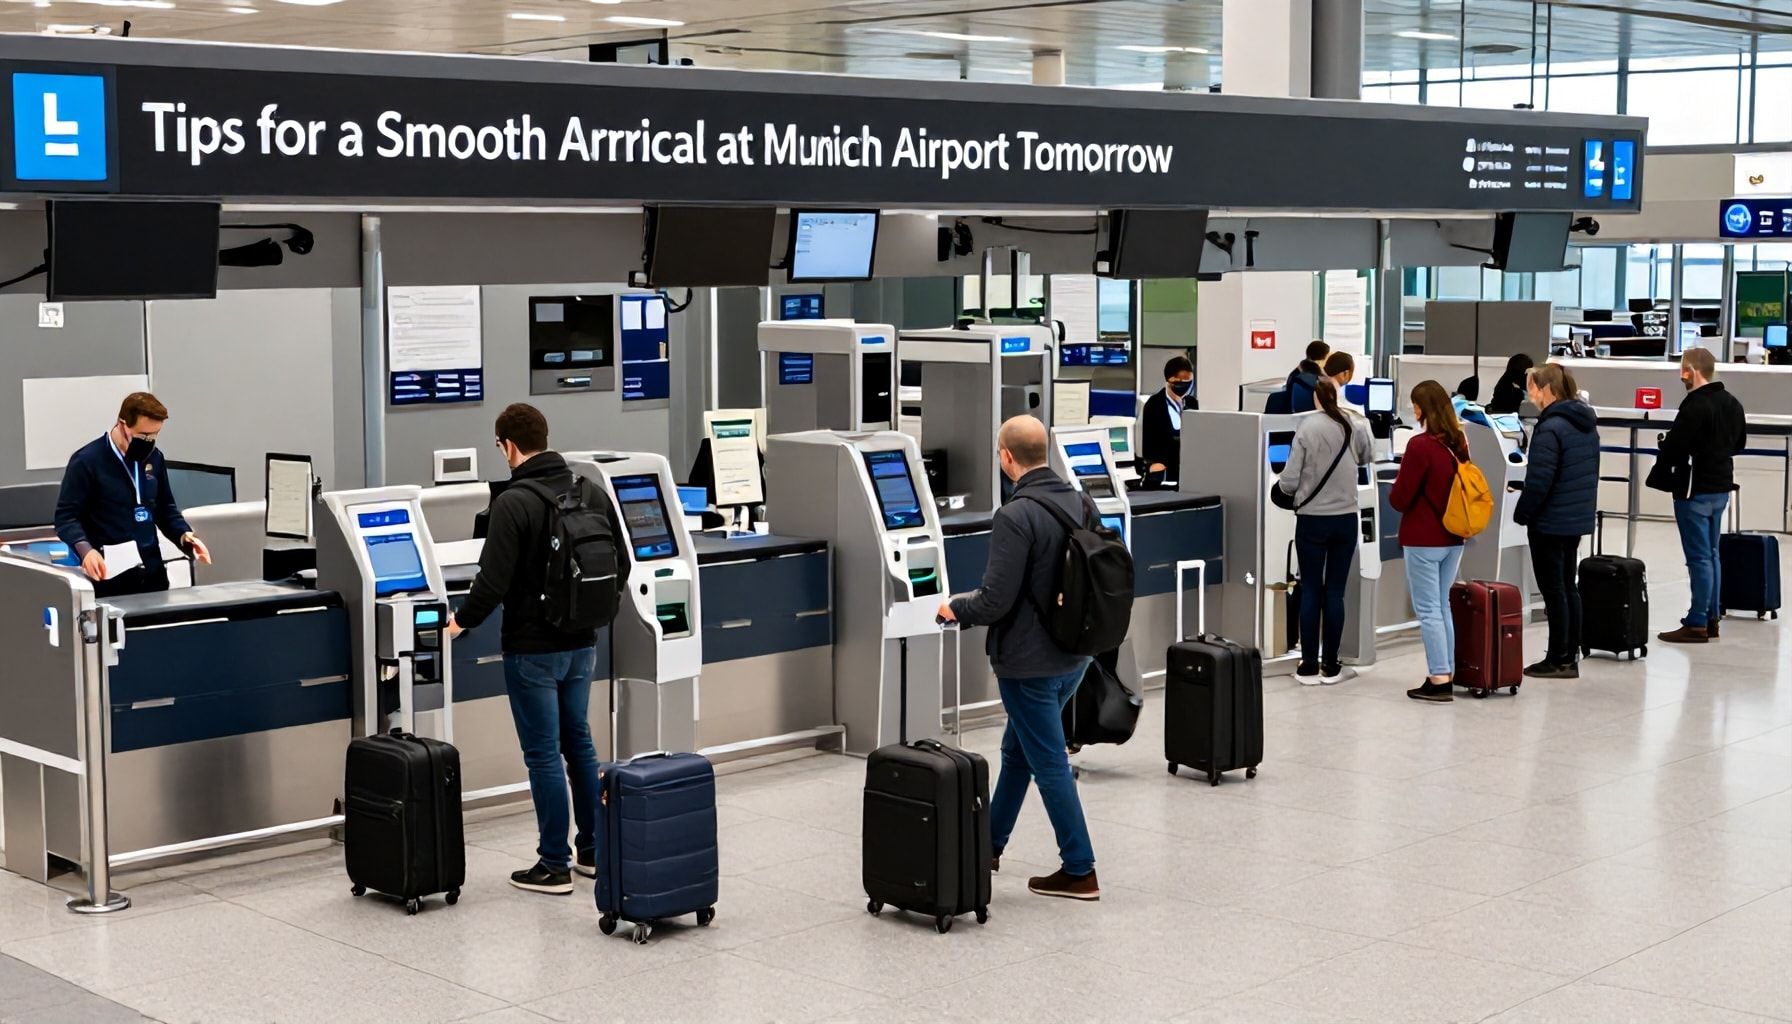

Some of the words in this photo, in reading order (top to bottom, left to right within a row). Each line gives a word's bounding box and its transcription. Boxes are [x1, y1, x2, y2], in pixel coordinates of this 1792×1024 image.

[141, 102, 246, 166] Tips
[256, 103, 327, 156] for
[337, 120, 364, 157] a
[376, 110, 546, 161] Smooth
[716, 125, 755, 166] at
[764, 122, 882, 168] Munich
[891, 126, 1010, 180] Airport
[1016, 130, 1174, 174] Tomorrow
